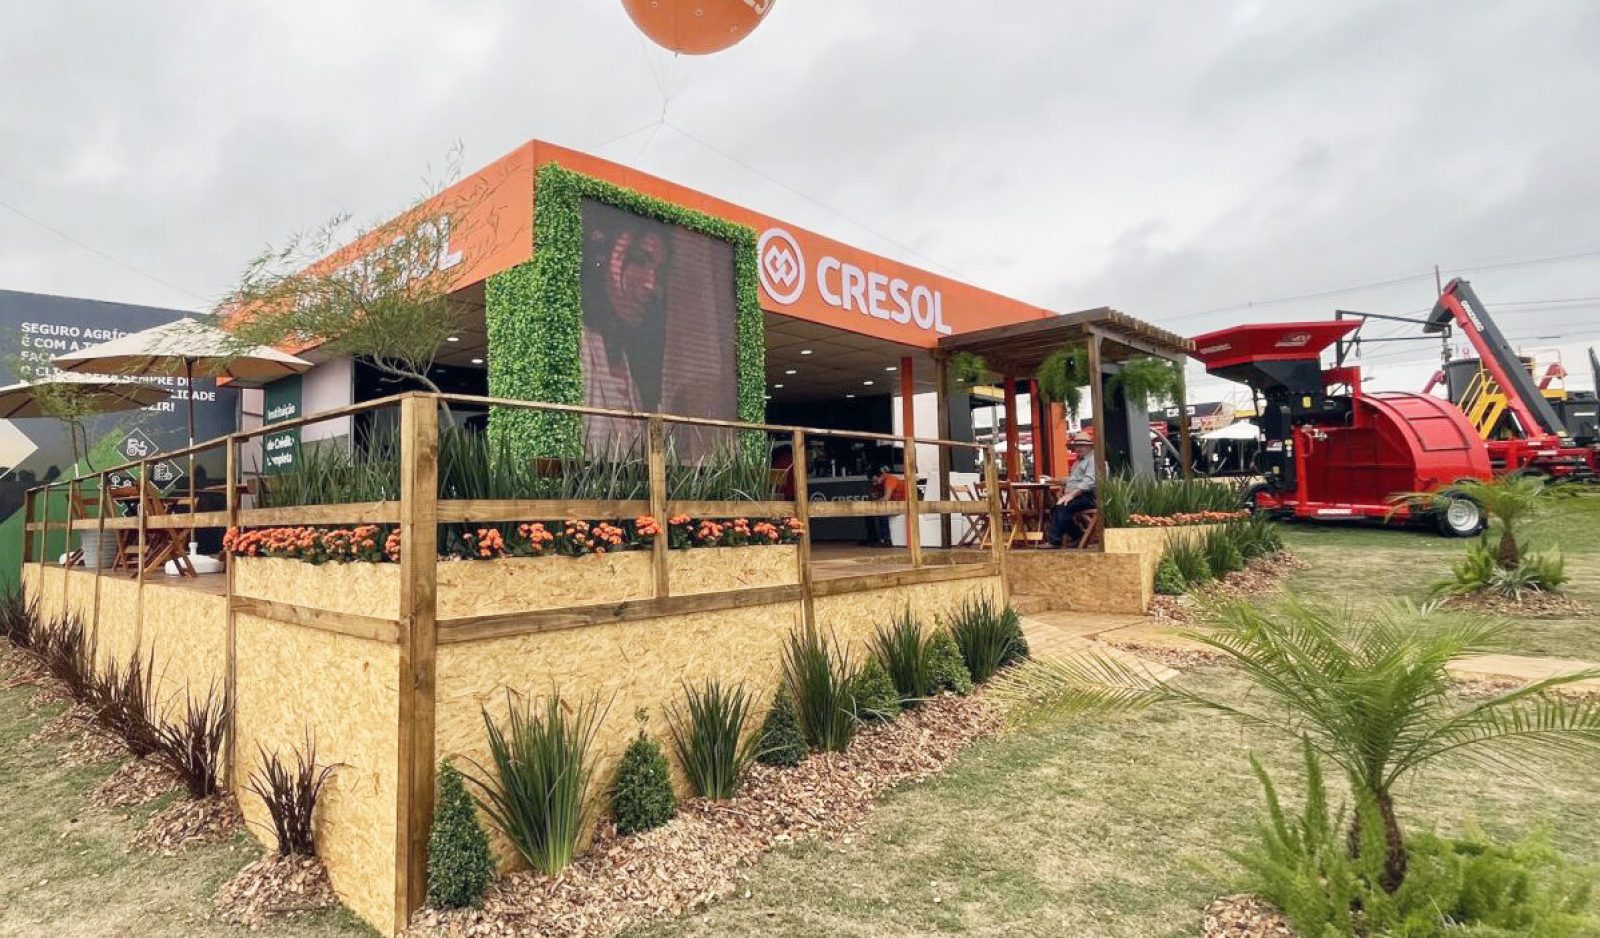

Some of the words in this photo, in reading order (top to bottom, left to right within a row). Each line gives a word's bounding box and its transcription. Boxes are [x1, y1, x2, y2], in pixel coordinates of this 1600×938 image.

[816, 255, 952, 335] CRESOL
[21, 321, 80, 338] SEGURO
[34, 337, 66, 351] COM
[70, 341, 80, 351] A
